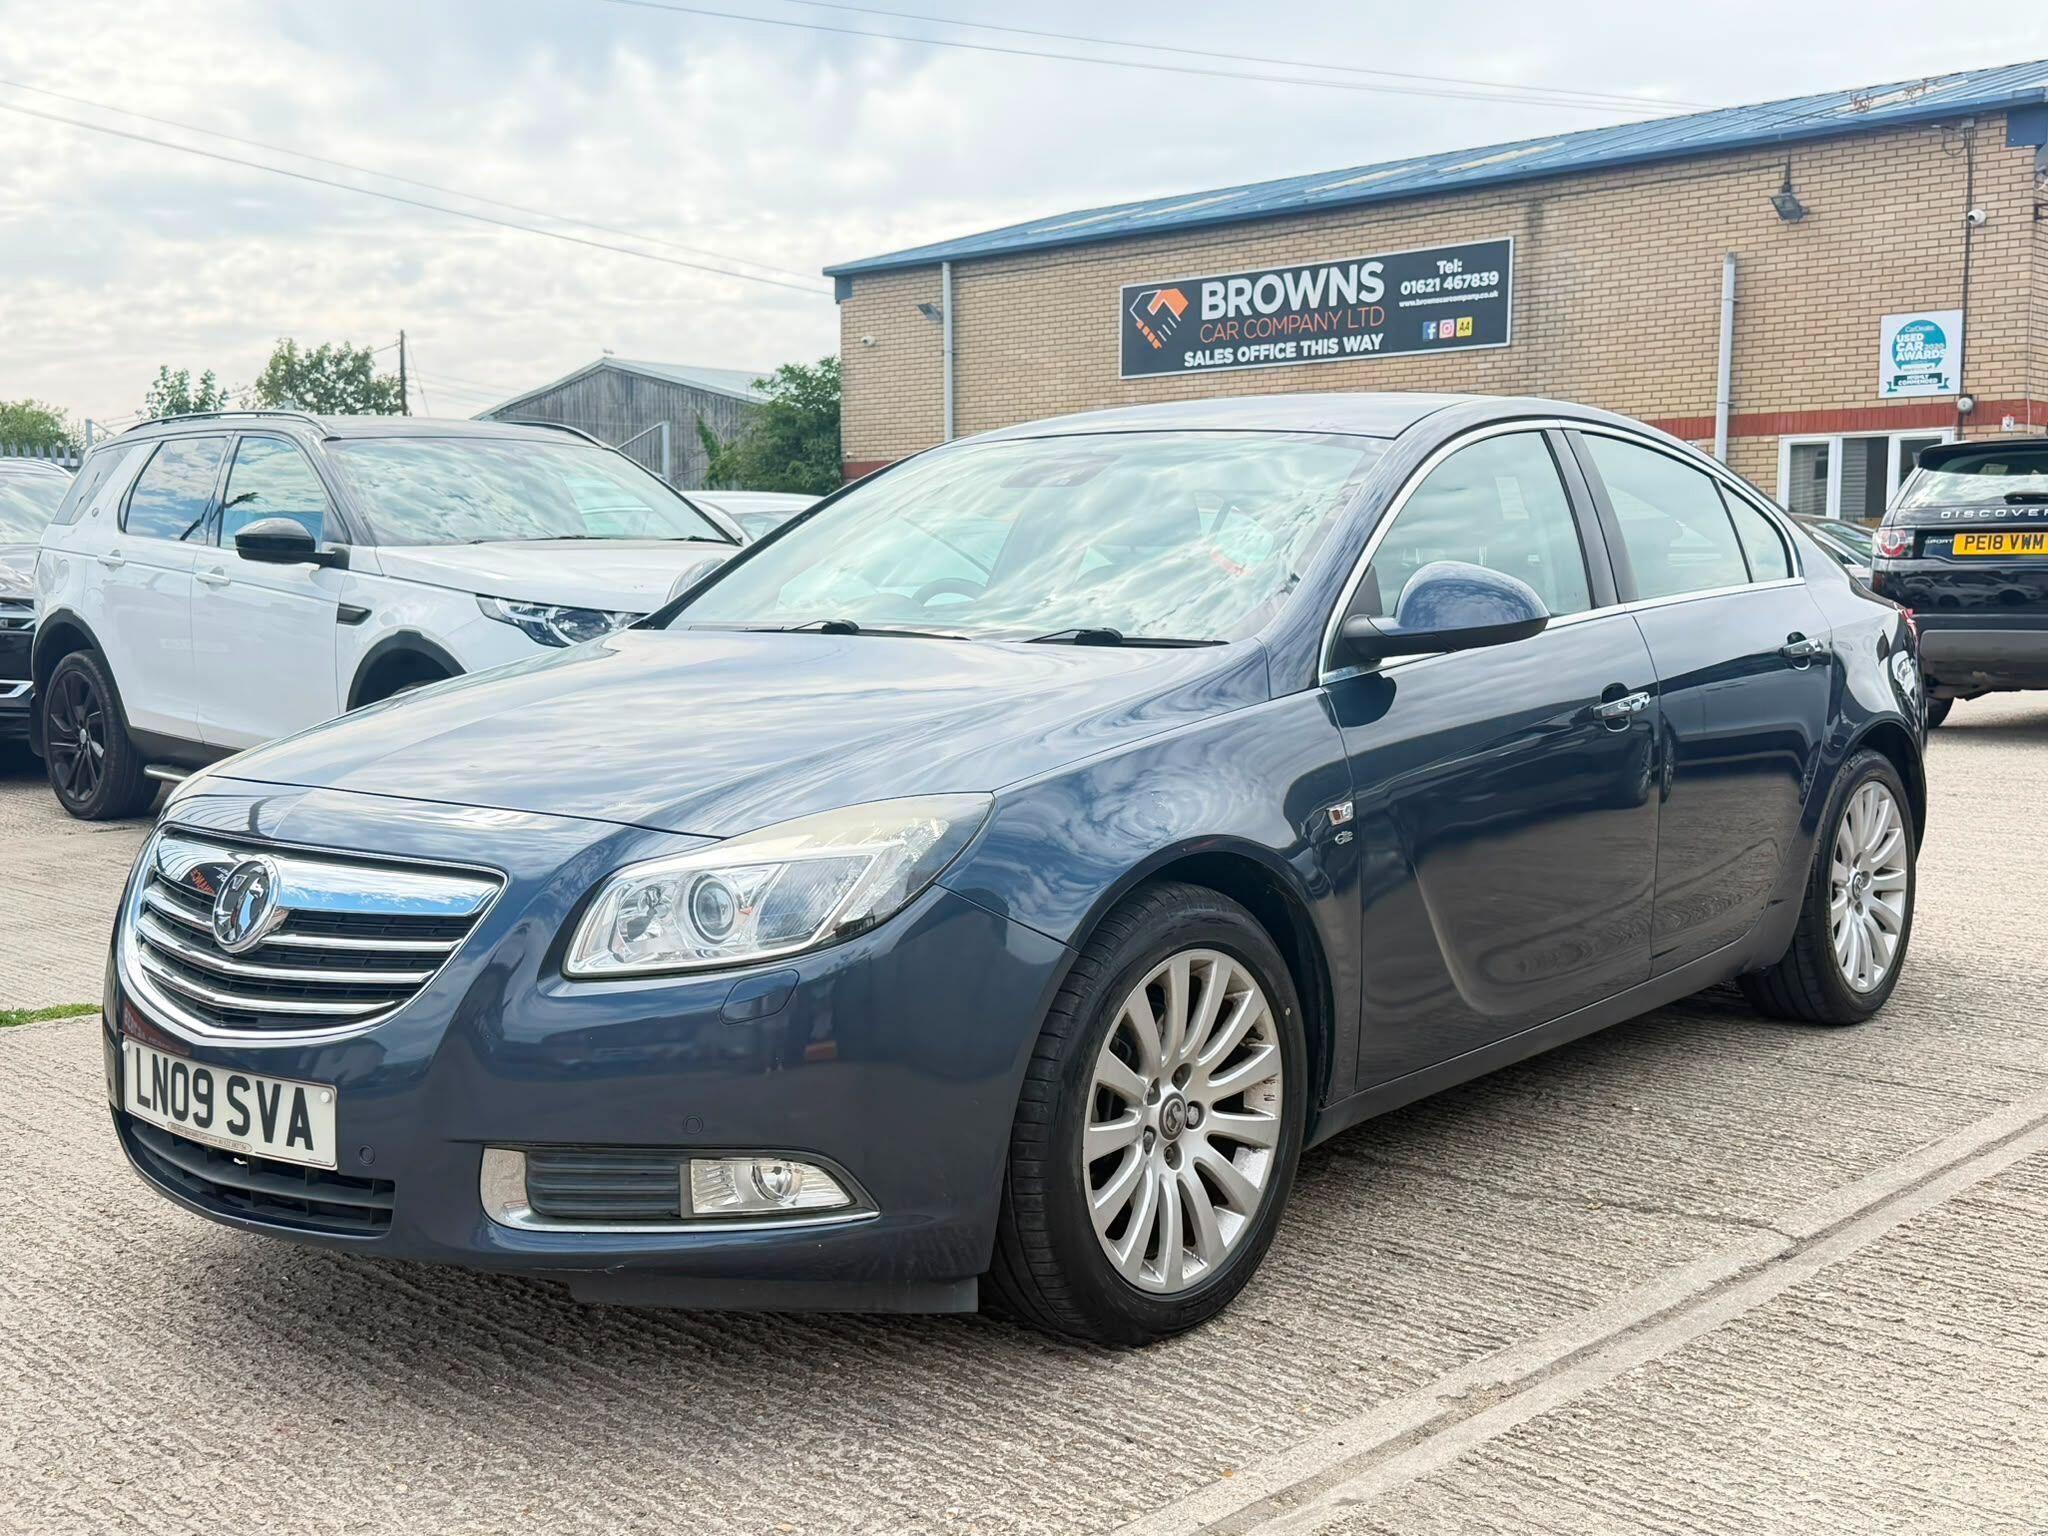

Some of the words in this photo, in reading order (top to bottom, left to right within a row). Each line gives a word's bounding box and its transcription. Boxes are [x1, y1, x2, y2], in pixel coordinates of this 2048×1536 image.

[1436, 258, 1463, 275] Tel:
[1201, 261, 1385, 320] BROWNS
[1400, 278, 1440, 295] 01621
[1443, 270, 1499, 291] 467839
[1200, 320, 1241, 344] CAR
[1243, 310, 1343, 339] COMPANY
[1347, 305, 1386, 329] LTD
[1896, 334, 1924, 342] USED
[1896, 342, 1924, 351] CAR
[1184, 348, 1235, 368] SALES
[1236, 341, 1298, 363] OFFICE
[1299, 337, 1340, 357] THIS
[1342, 332, 1385, 353] WAY
[1896, 350, 1945, 361] AWARDS
[1964, 536, 2004, 550] PE18
[2010, 534, 2046, 550] VWM
[136, 1047, 214, 1128] LN09
[226, 1076, 315, 1151] SVA
